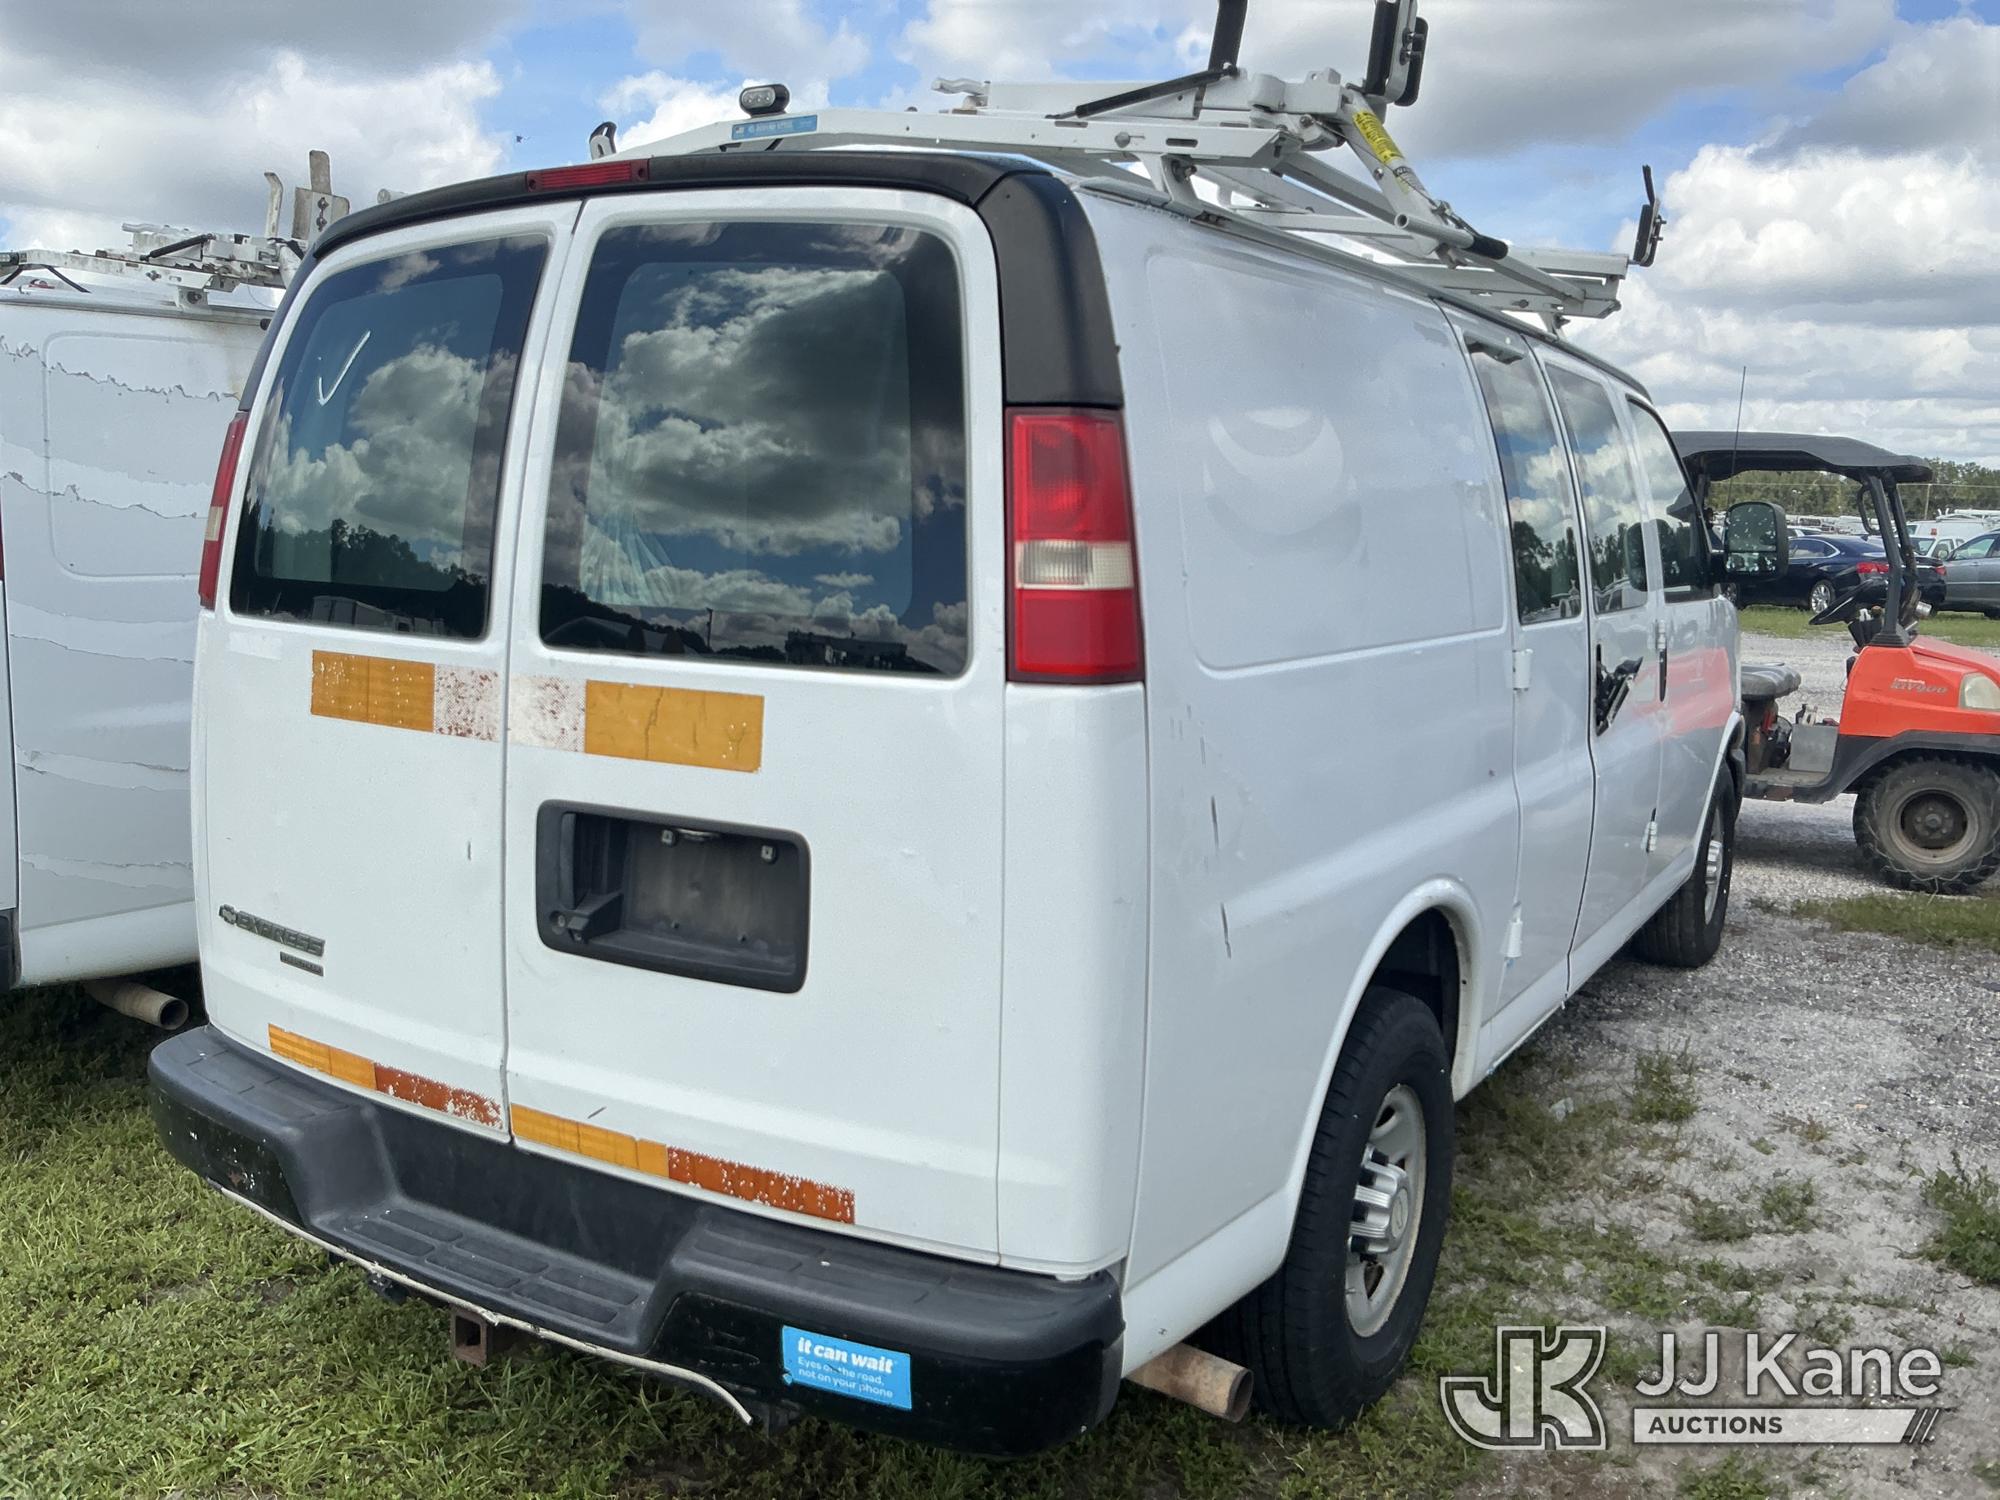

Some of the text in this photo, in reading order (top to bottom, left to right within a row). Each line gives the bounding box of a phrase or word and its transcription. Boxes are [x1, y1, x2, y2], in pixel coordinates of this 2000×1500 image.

[236, 910, 325, 957] EXPRESS
[798, 1336, 893, 1374] it can wait
[798, 1356, 822, 1370] Eyes
[857, 1371, 885, 1386] road,
[798, 1368, 894, 1398] not on your phone
